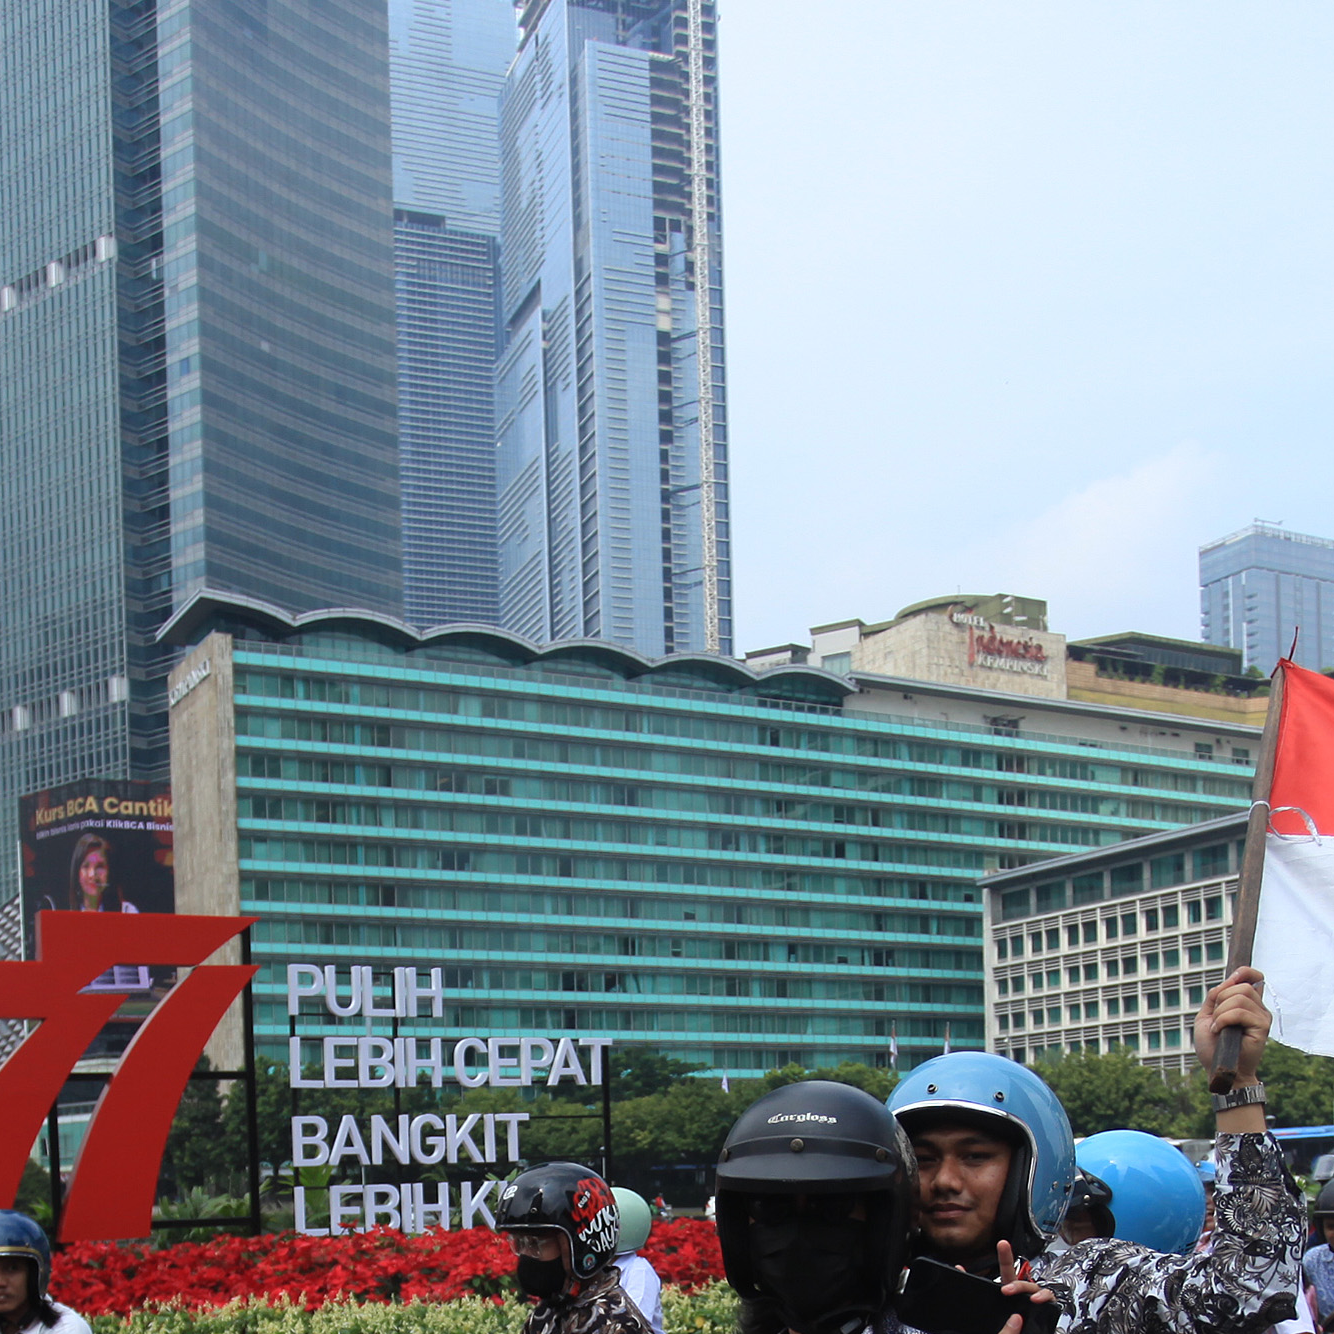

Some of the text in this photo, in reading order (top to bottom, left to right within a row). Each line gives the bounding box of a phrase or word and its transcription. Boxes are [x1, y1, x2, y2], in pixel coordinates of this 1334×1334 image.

[952, 612, 985, 627] HOTEL
[977, 652, 1048, 676] KEMPINSKI
[35, 796, 173, 826] Kurs BCA Cantik
[287, 963, 443, 1018] PULIH
[289, 1036, 613, 1088] LEBIH CEPAT
[767, 1112, 838, 1125] Cargloss
[291, 1112, 530, 1167] BANGKIT
[294, 1180, 511, 1237] LEBIH K
